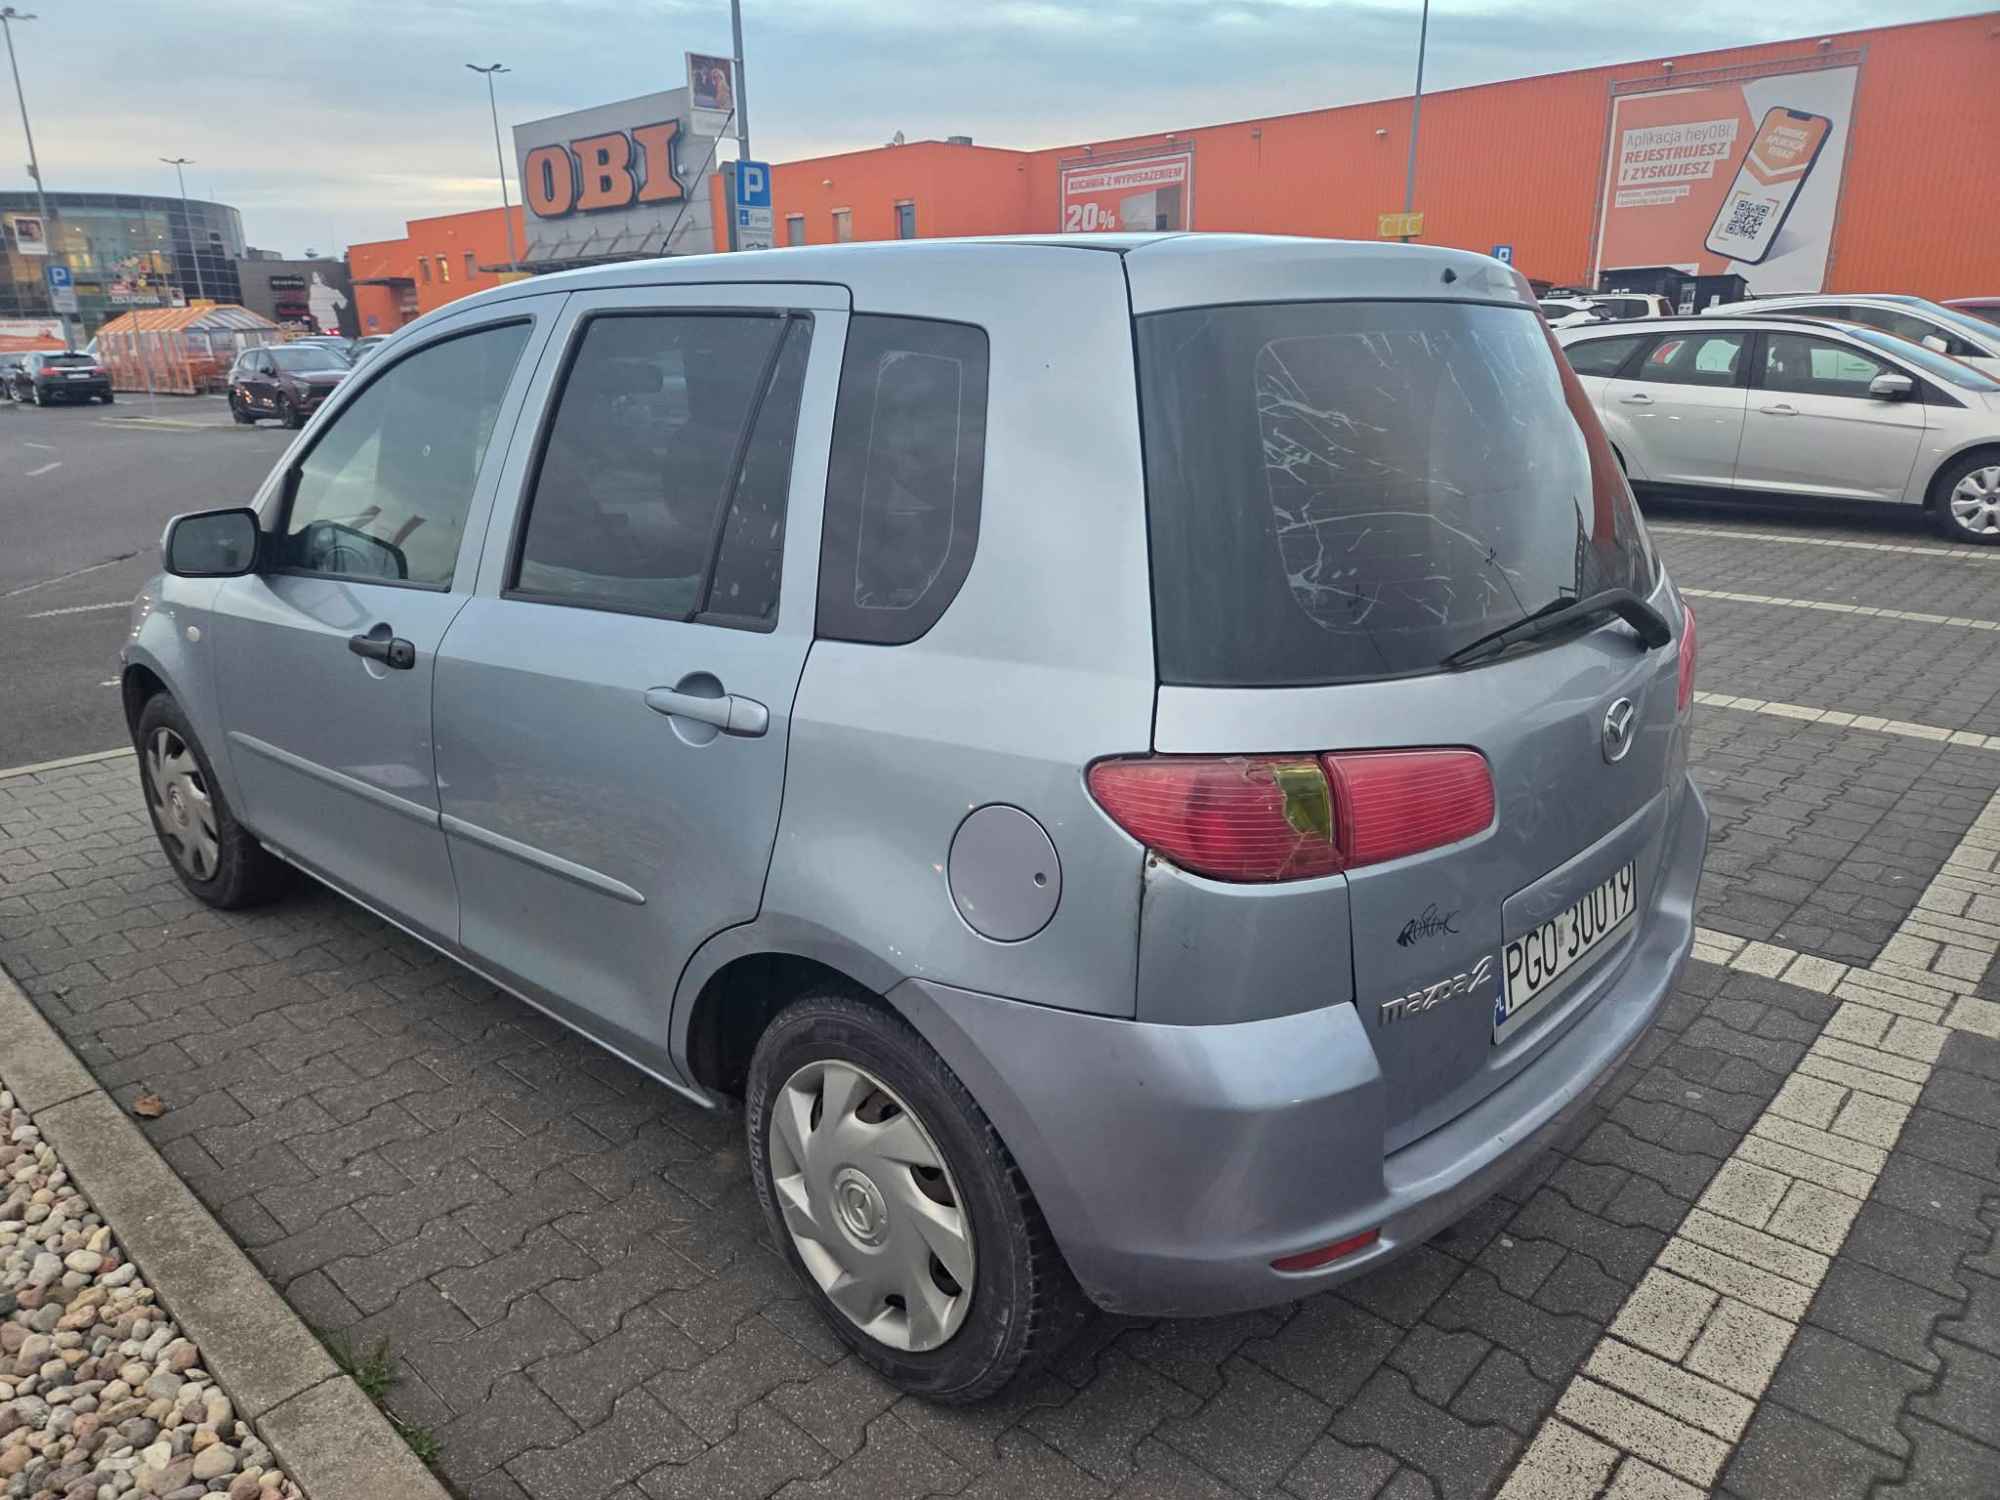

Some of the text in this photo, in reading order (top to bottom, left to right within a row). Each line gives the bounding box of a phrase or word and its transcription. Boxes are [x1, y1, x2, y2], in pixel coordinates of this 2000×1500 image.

[1626, 129, 1681, 147] Aplikacja
[1624, 143, 1727, 164] REJESTRUJESZ
[525, 119, 685, 217] OBI
[1630, 161, 1711, 180] ZYSKUJESZ
[744, 167, 763, 201] P
[1066, 202, 1116, 232] 20%
[52, 268, 66, 283] P
[1506, 864, 1631, 1009] PGO 30019
